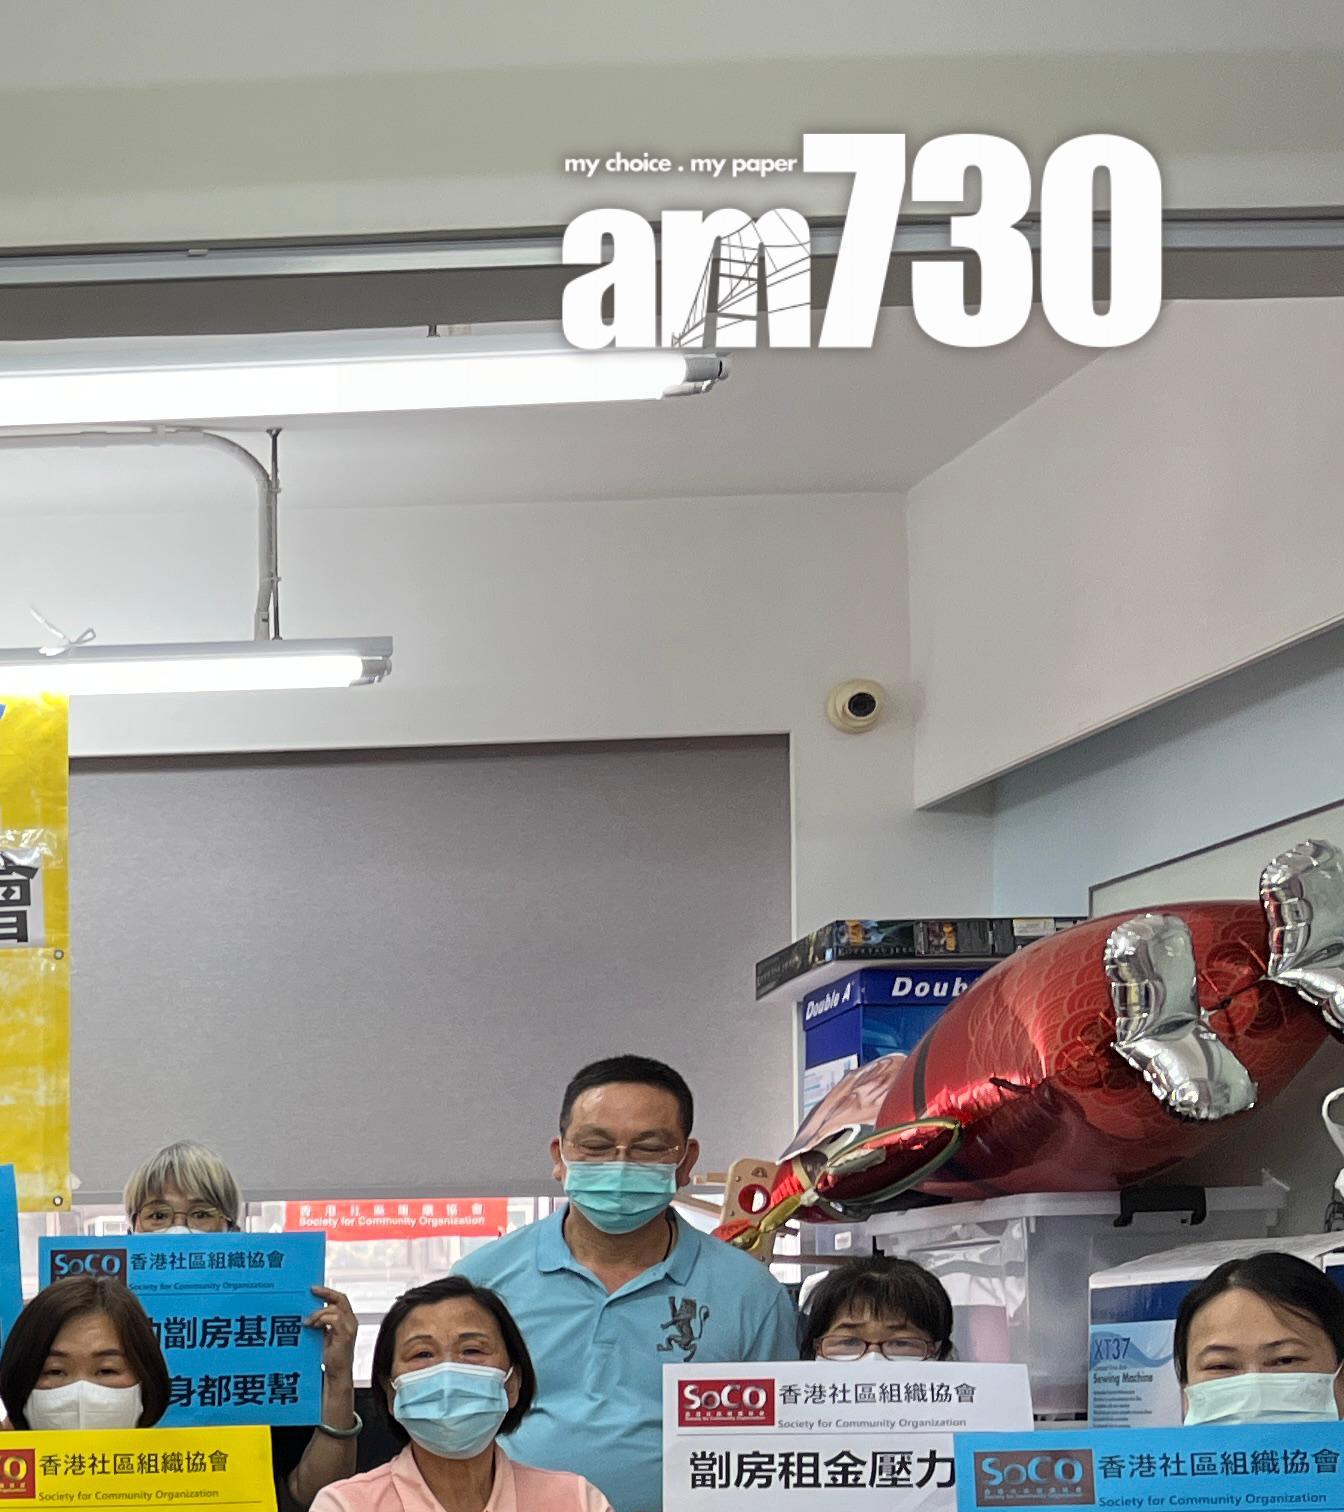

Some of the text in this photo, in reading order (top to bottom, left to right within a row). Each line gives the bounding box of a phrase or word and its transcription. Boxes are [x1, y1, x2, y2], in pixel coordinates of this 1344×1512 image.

[892, 976, 967, 997] Doub
[805, 982, 852, 1021] Double A
[299, 1216, 484, 1229] Society for Community Organization
[131, 1251, 284, 1271] 香港社區組織協會
[1094, 1338, 1130, 1360] XT37
[1094, 1372, 1153, 1386] Sewing Machine
[779, 1382, 977, 1404] 香港社區組織協會
[40, 1450, 229, 1476] 香港社區組織協會
[690, 1450, 956, 1489] 劏房租金壓力
[1098, 1448, 1339, 1479] 香港社區組織協會
[1100, 1492, 1326, 1508] Society for Community Organization
